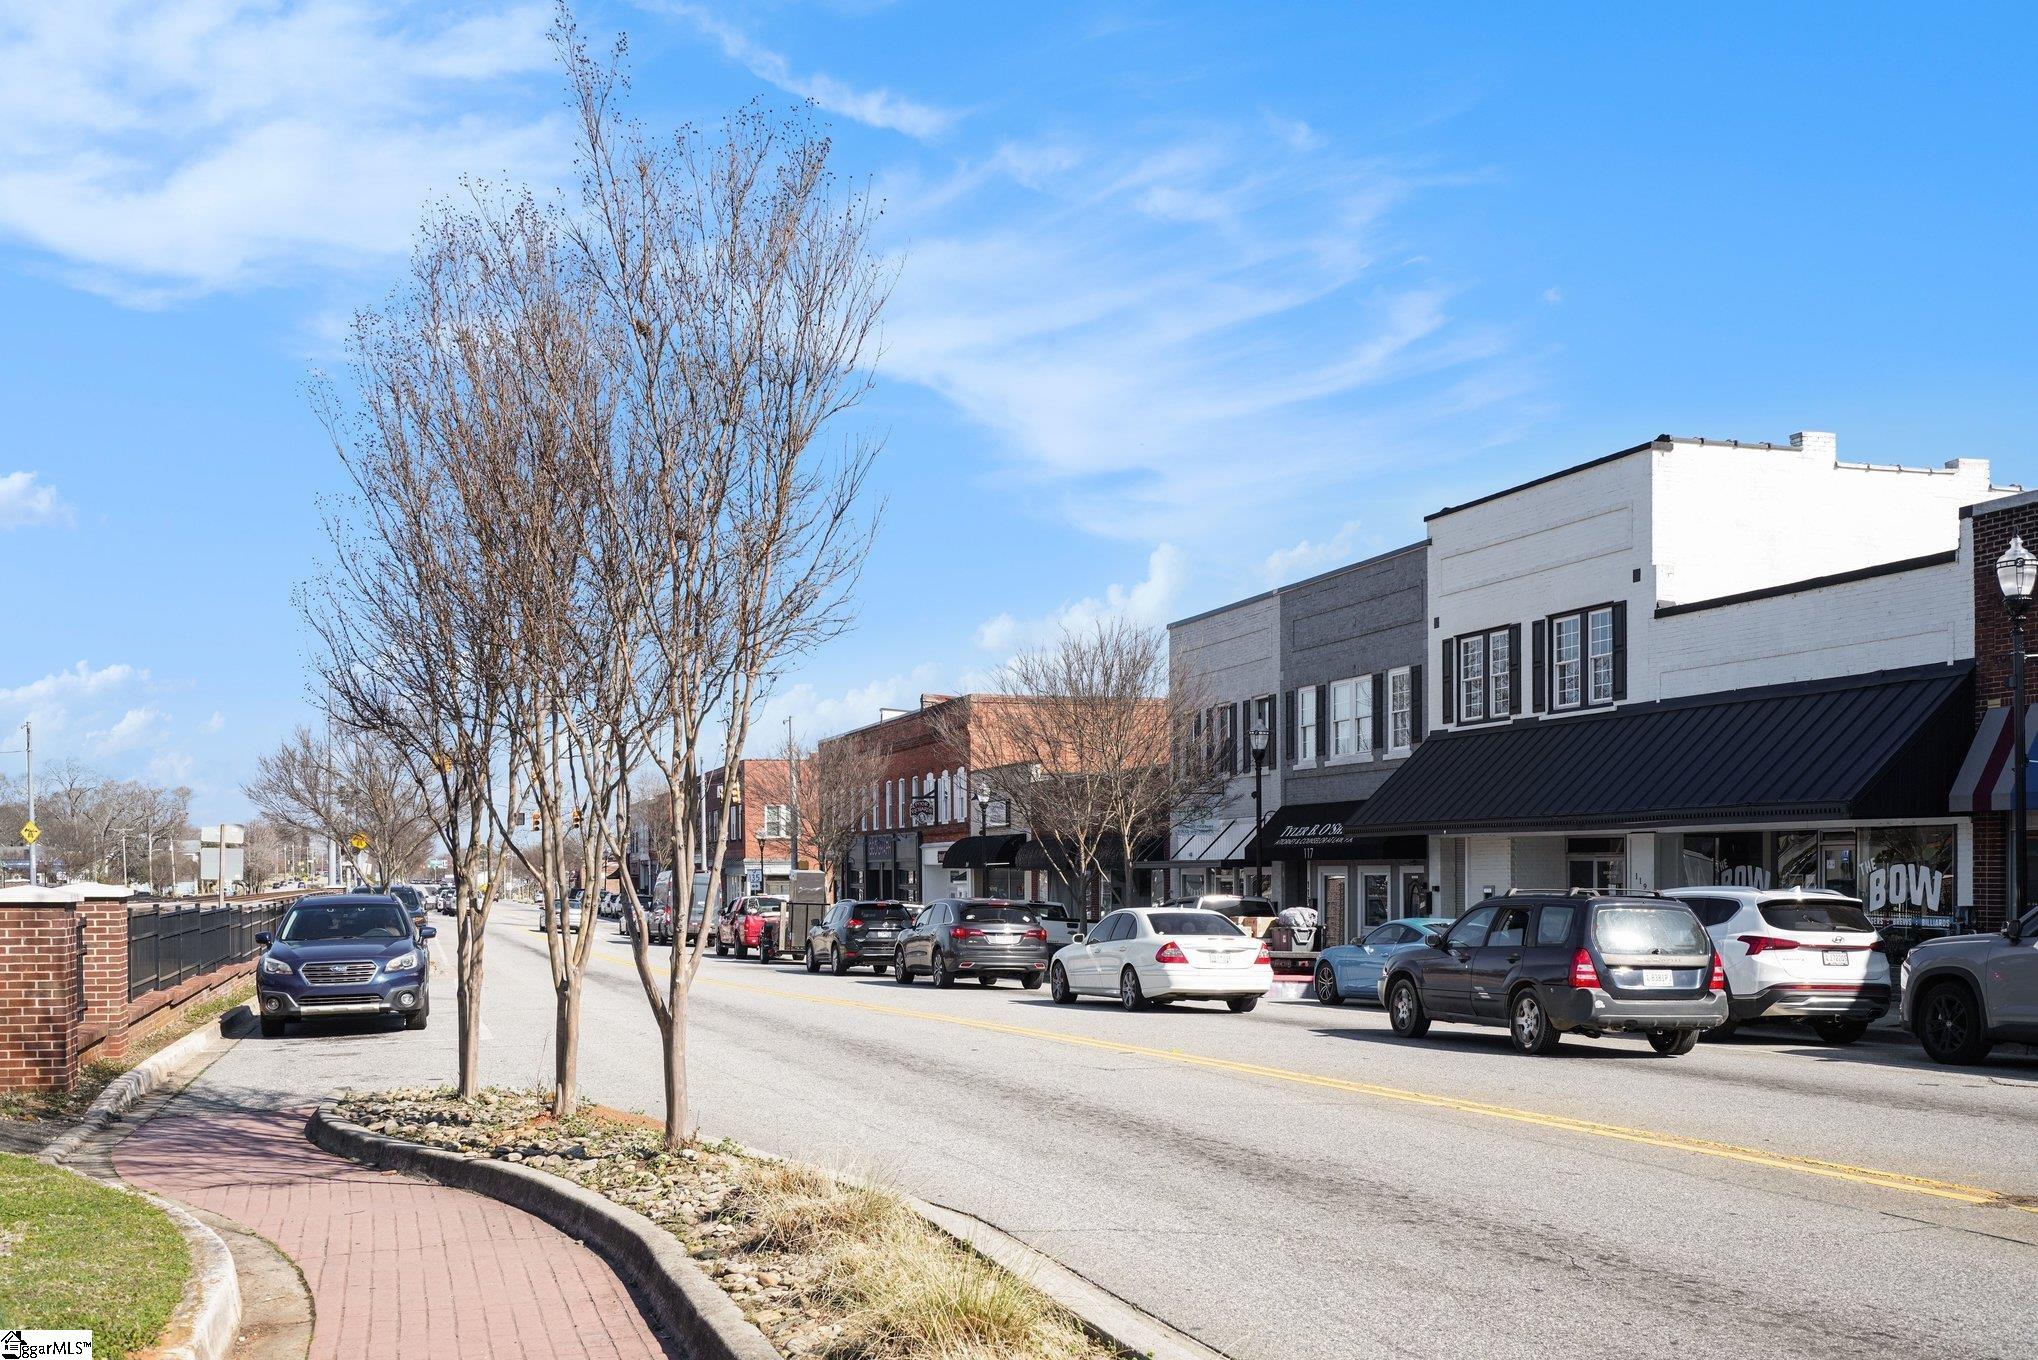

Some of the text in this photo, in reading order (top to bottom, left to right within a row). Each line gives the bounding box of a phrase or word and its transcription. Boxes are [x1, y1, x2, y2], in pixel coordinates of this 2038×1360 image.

[1280, 825, 1309, 837] TYLER
[1308, 824, 1320, 836] B.
[1304, 848, 1314, 859] 117
[1859, 857, 1877, 875] THE
[1721, 865, 1771, 890] BOW
[1869, 864, 1943, 911] BOW
[1921, 919, 1950, 927] BILLIARDS
